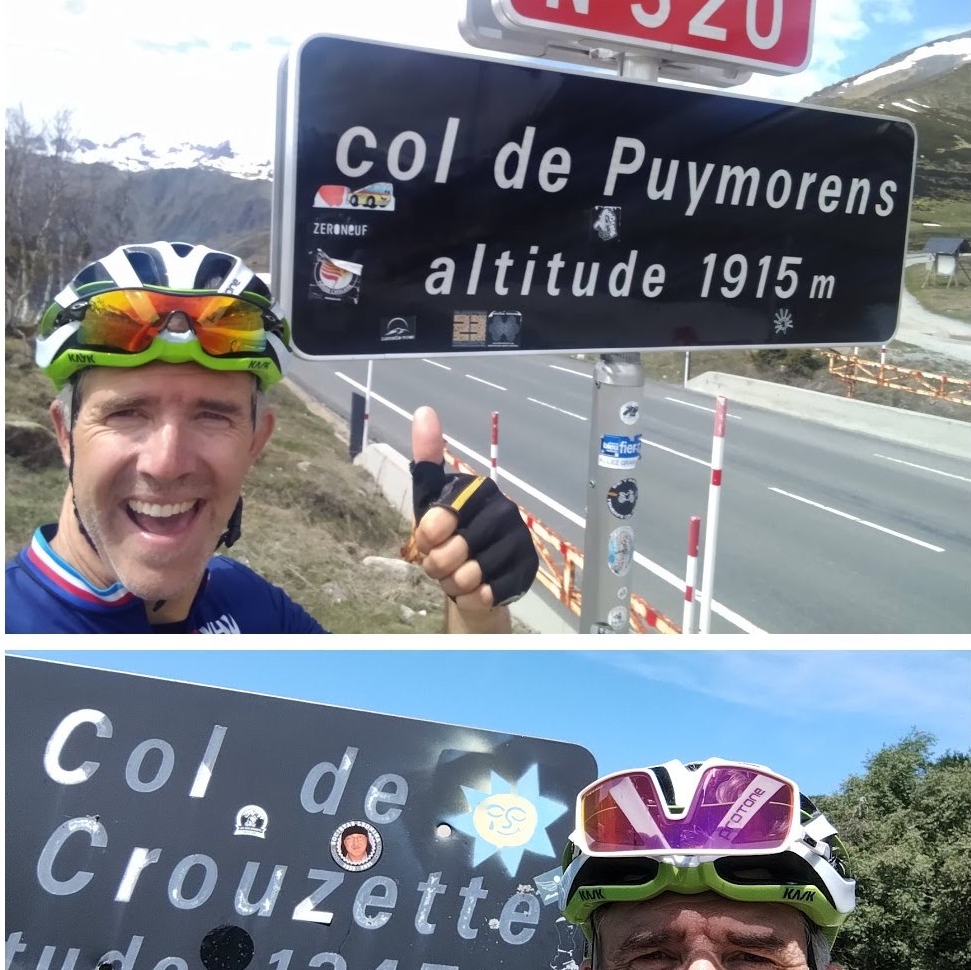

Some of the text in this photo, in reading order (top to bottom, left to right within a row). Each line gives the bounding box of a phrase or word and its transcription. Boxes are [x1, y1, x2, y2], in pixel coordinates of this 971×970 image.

[335, 116, 898, 217] col de Puymorens
[424, 243, 836, 300] altitude 1915 m
[43, 708, 409, 825] Col de
[36, 816, 541, 946] Crouzette
